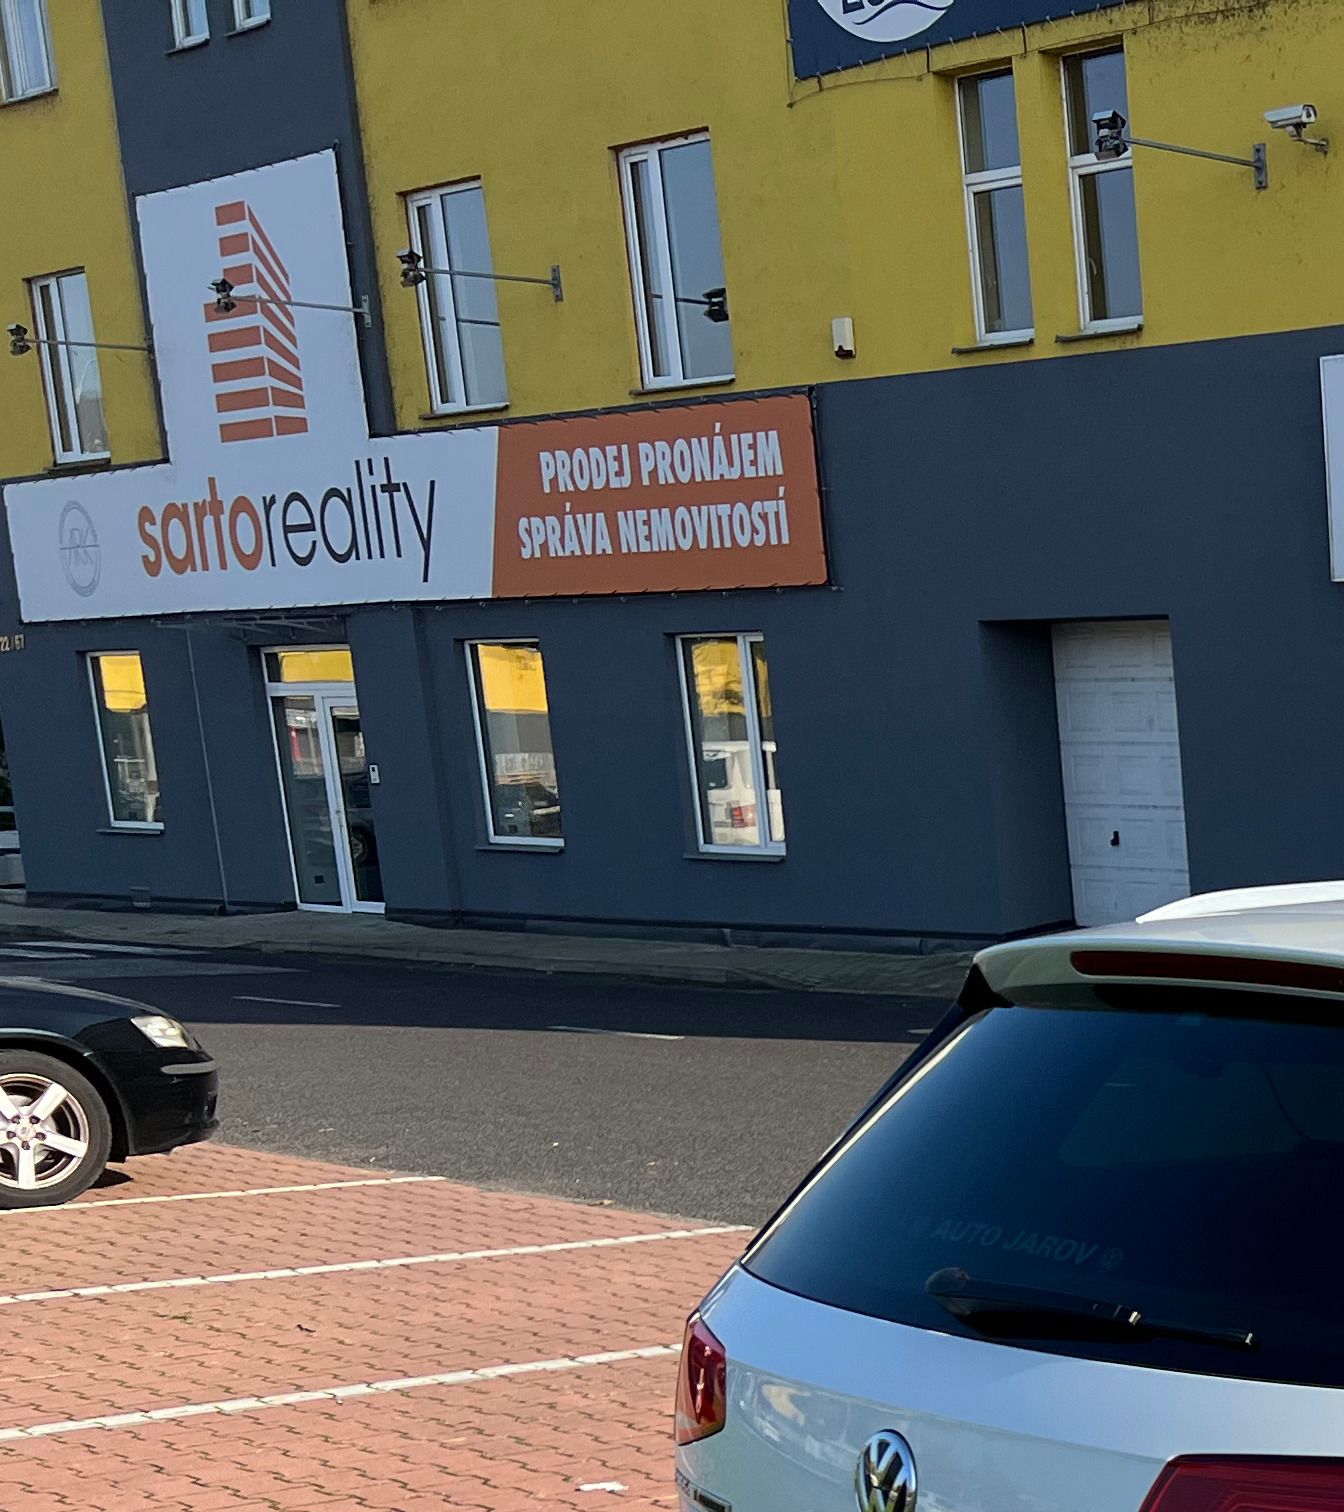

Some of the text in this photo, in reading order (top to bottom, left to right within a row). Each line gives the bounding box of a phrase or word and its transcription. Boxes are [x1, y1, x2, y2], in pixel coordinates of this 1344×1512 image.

[539, 422, 783, 493] PRODEJ PRONÁJEM
[137, 457, 435, 583] sartoreality
[518, 486, 790, 559] SPRÁVA NEMOVITOSTÍ
[930, 1219, 1100, 1264] AUTO JAROV
